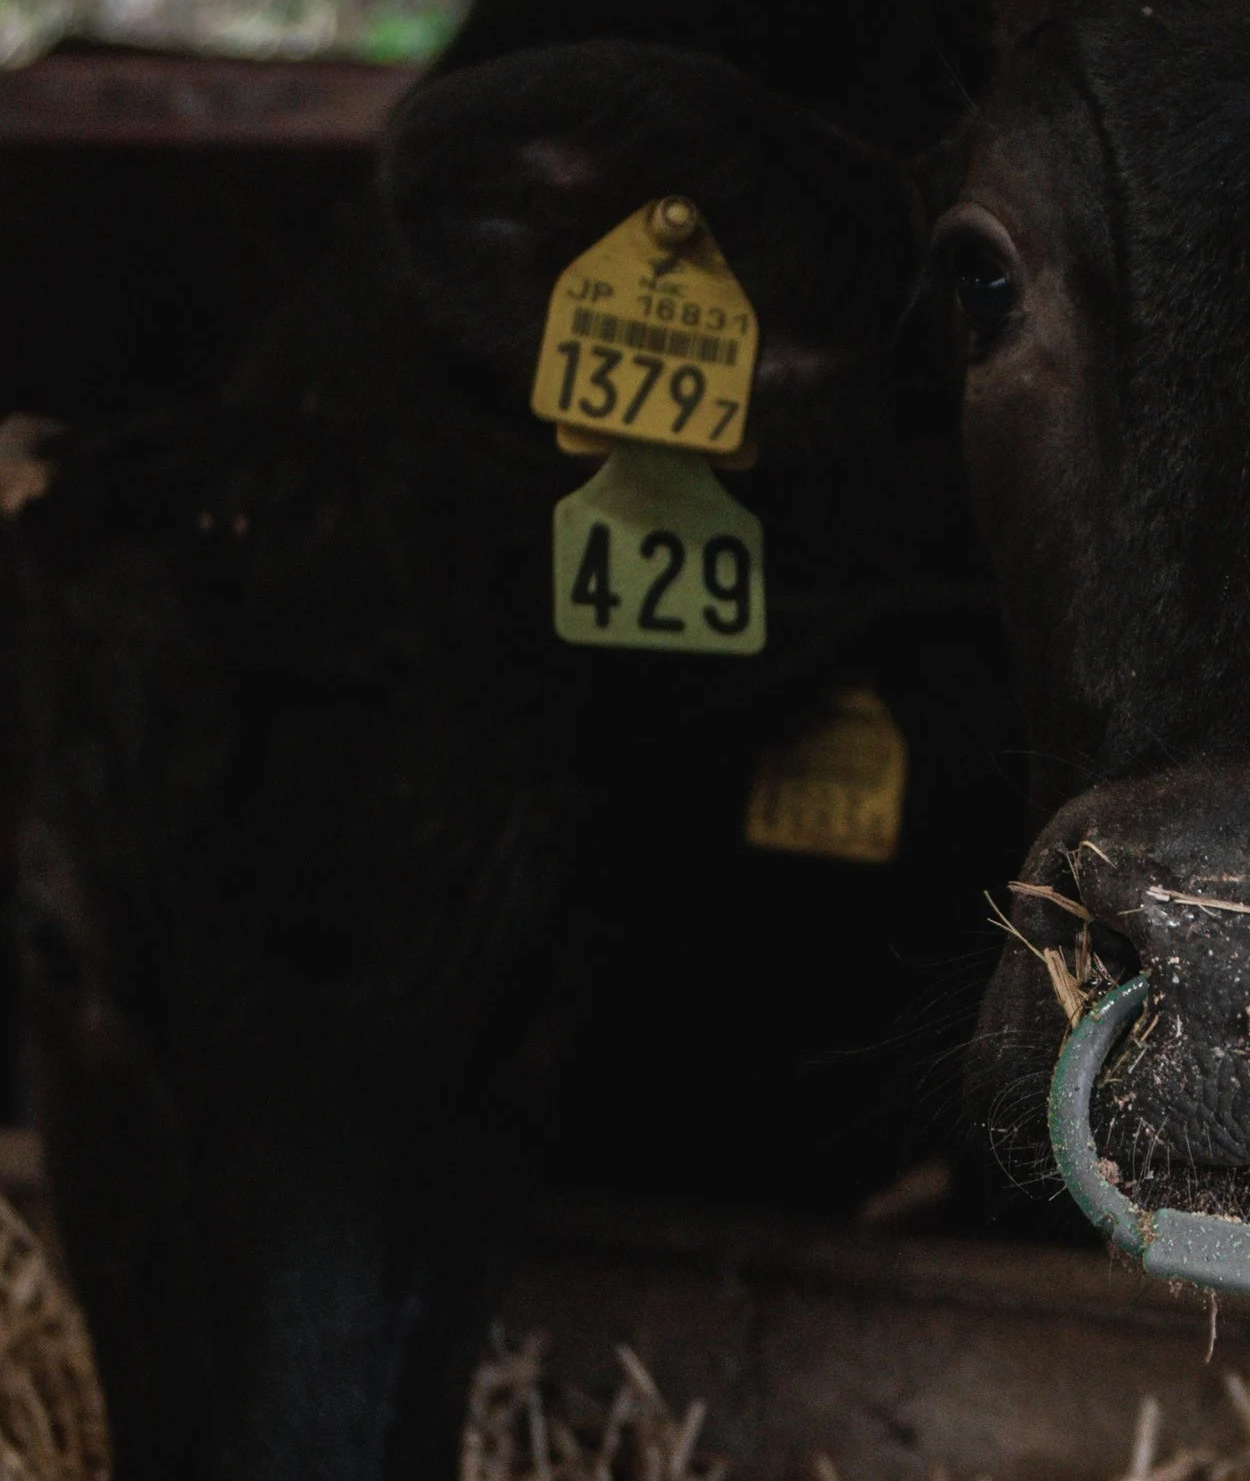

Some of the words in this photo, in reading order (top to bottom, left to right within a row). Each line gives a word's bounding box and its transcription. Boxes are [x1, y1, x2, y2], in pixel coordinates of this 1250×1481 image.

[566, 277, 614, 303] JP
[636, 295, 750, 336] 16831
[556, 340, 741, 441] 13797
[570, 521, 750, 636] 429
